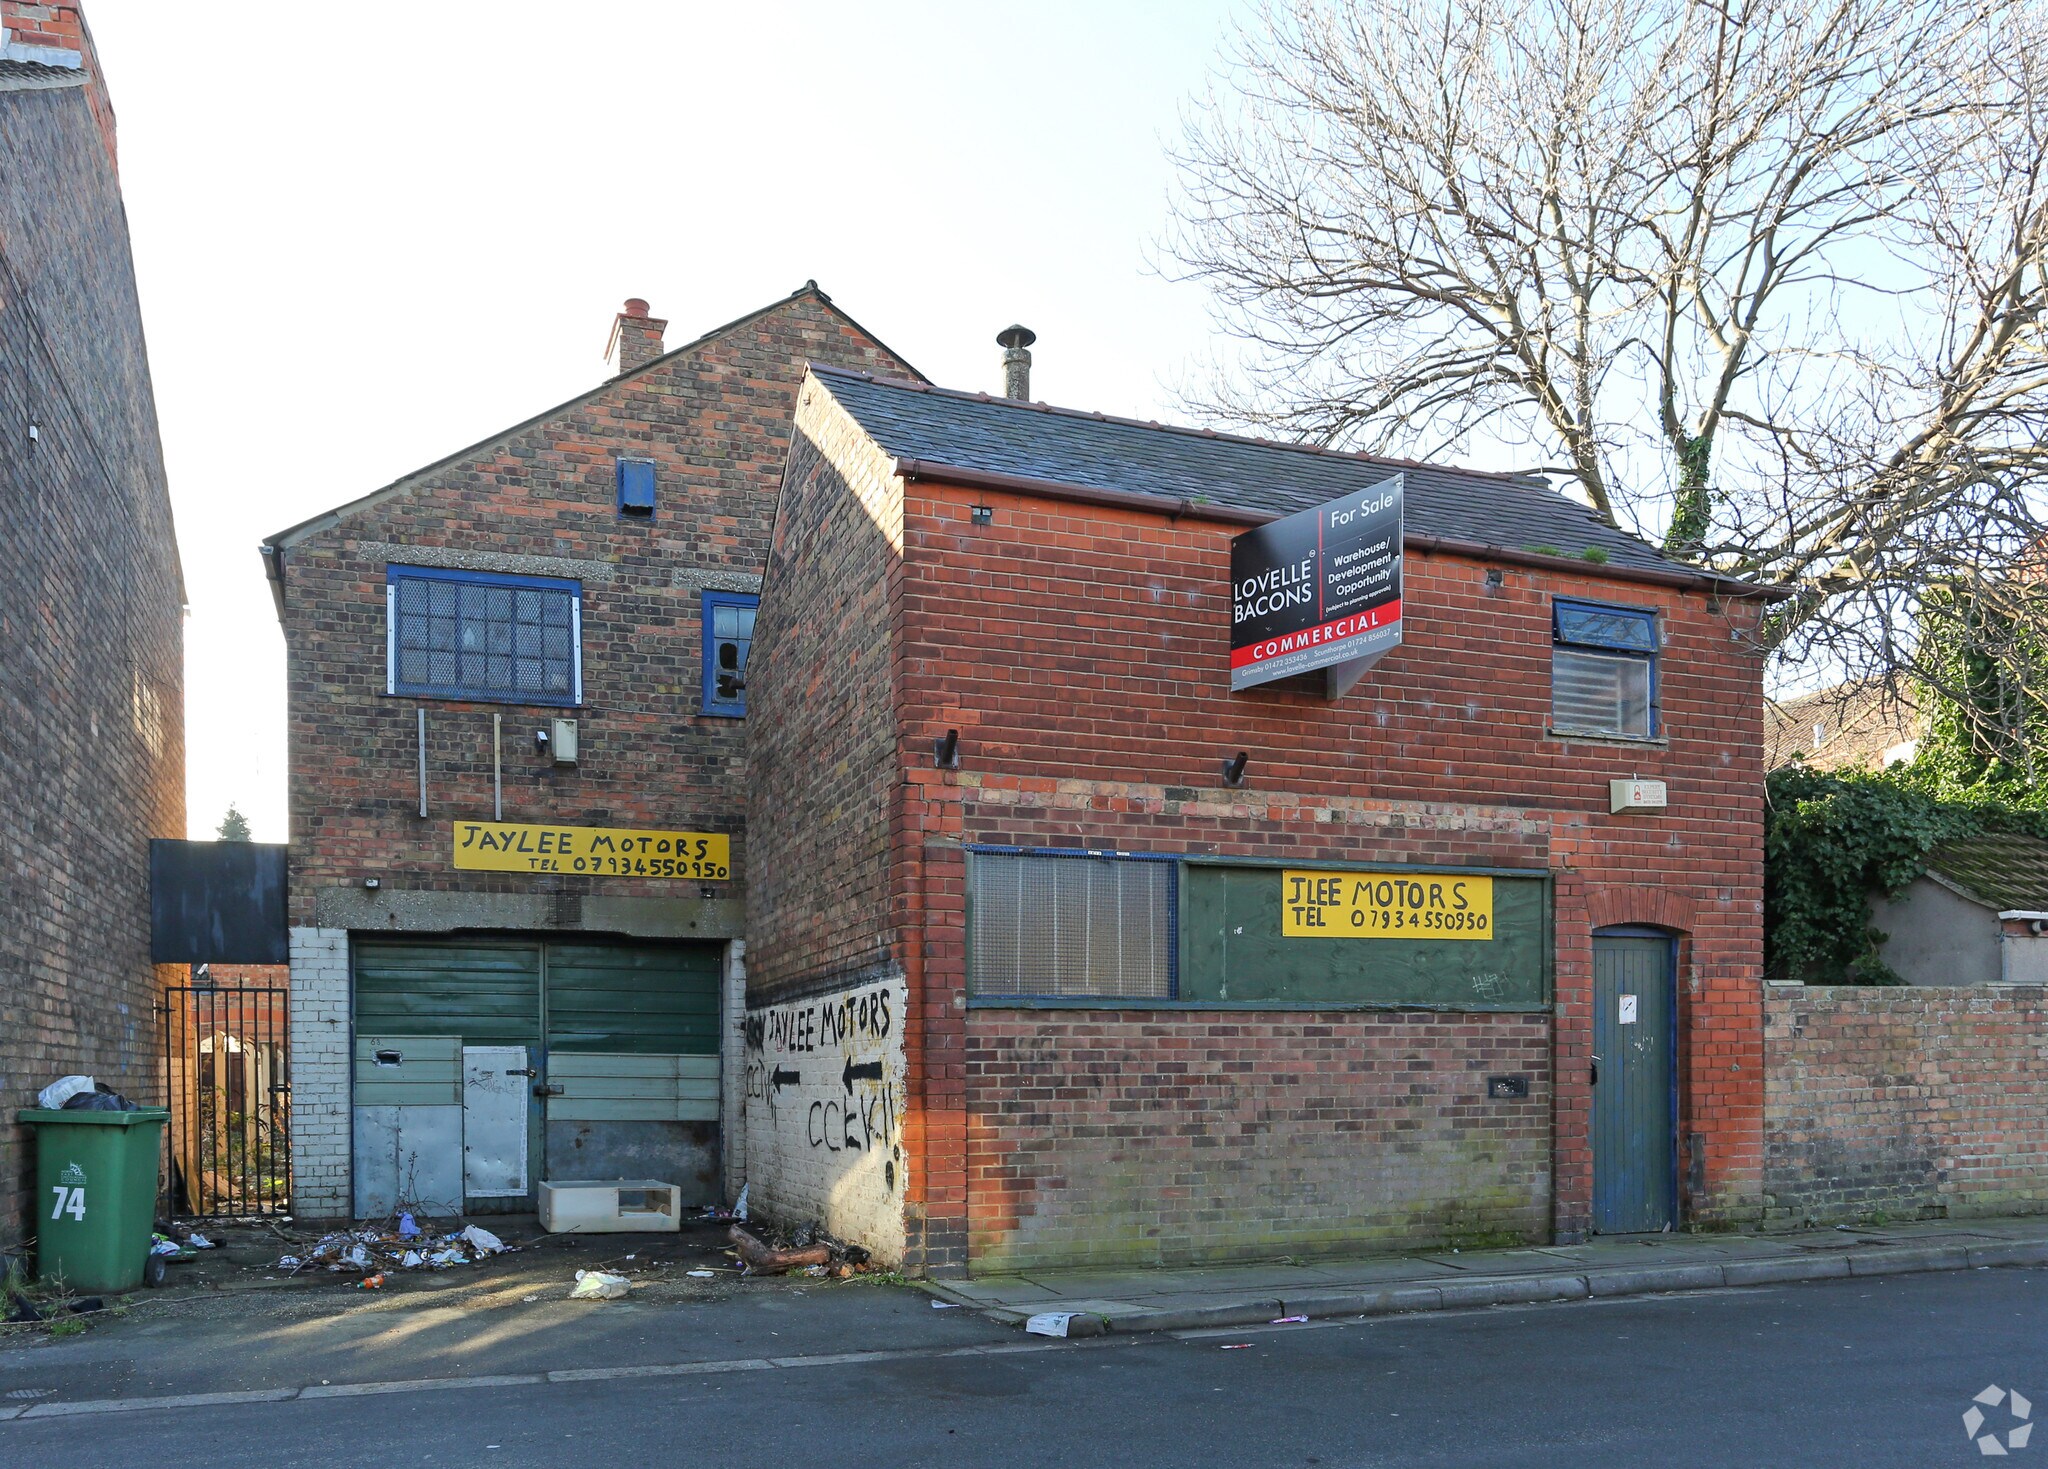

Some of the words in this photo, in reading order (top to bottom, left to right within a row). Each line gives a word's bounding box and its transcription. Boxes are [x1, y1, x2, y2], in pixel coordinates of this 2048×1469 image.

[1331, 508, 1356, 529] For
[1361, 492, 1394, 519] Sale
[1328, 552, 1392, 585] Development
[1334, 536, 1391, 568] Warehouse/
[1234, 559, 1312, 602] LOVELLE
[1336, 568, 1392, 597] Opportunity
[1234, 583, 1312, 624] BACONS
[1241, 666, 1264, 677] Grimsby
[1264, 660, 1284, 671] 01472
[1284, 653, 1308, 666] 353436
[1313, 644, 1347, 658] Scunthorpe
[1347, 636, 1367, 648] 01724
[1367, 628, 1391, 642] 856037
[1253, 611, 1379, 660] COMMERCIAL
[1272, 649, 1358, 676] www.lovelle-commercial.co.uk
[462, 825, 573, 854] JAYLEE
[590, 835, 709, 861] MOTORS
[528, 857, 560, 872] TEL
[573, 857, 728, 879] 07934550950
[1287, 877, 1343, 906] JLEE
[1352, 880, 1469, 910] MOTORS
[1291, 906, 1327, 927] TEL
[1351, 910, 1488, 931] 07934550950
[769, 1008, 815, 1052] JAYLEE
[820, 988, 891, 1047] MOTORS
[51, 1186, 86, 1221] 74
